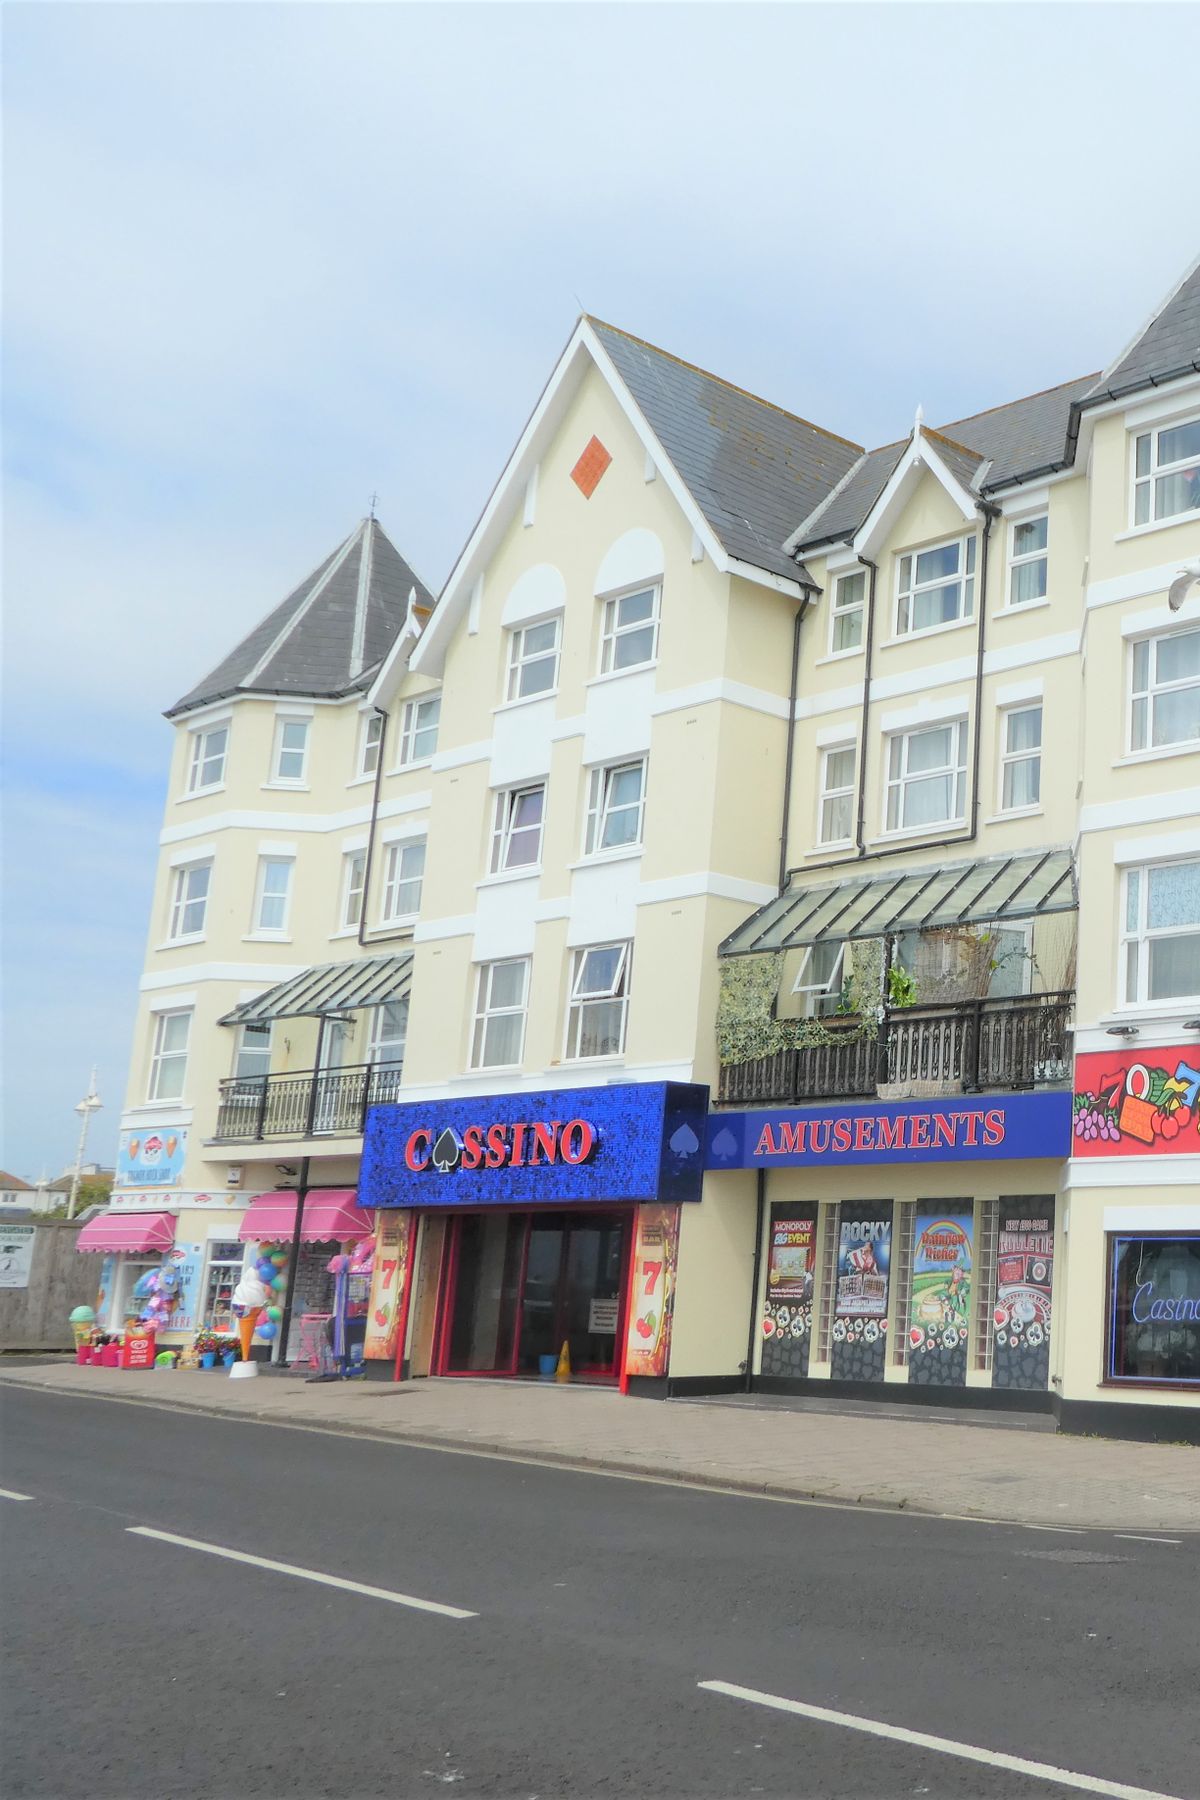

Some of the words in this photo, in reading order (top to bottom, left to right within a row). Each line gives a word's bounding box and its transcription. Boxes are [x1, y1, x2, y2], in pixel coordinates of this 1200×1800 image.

[754, 1109, 1006, 1155] AMUSEMENTS
[775, 1222, 812, 1231] MONOPOLY
[788, 1232, 811, 1244] EVENT
[841, 1221, 890, 1241] ROCKY
[382, 1260, 397, 1289] 7
[643, 1261, 662, 1295] 7
